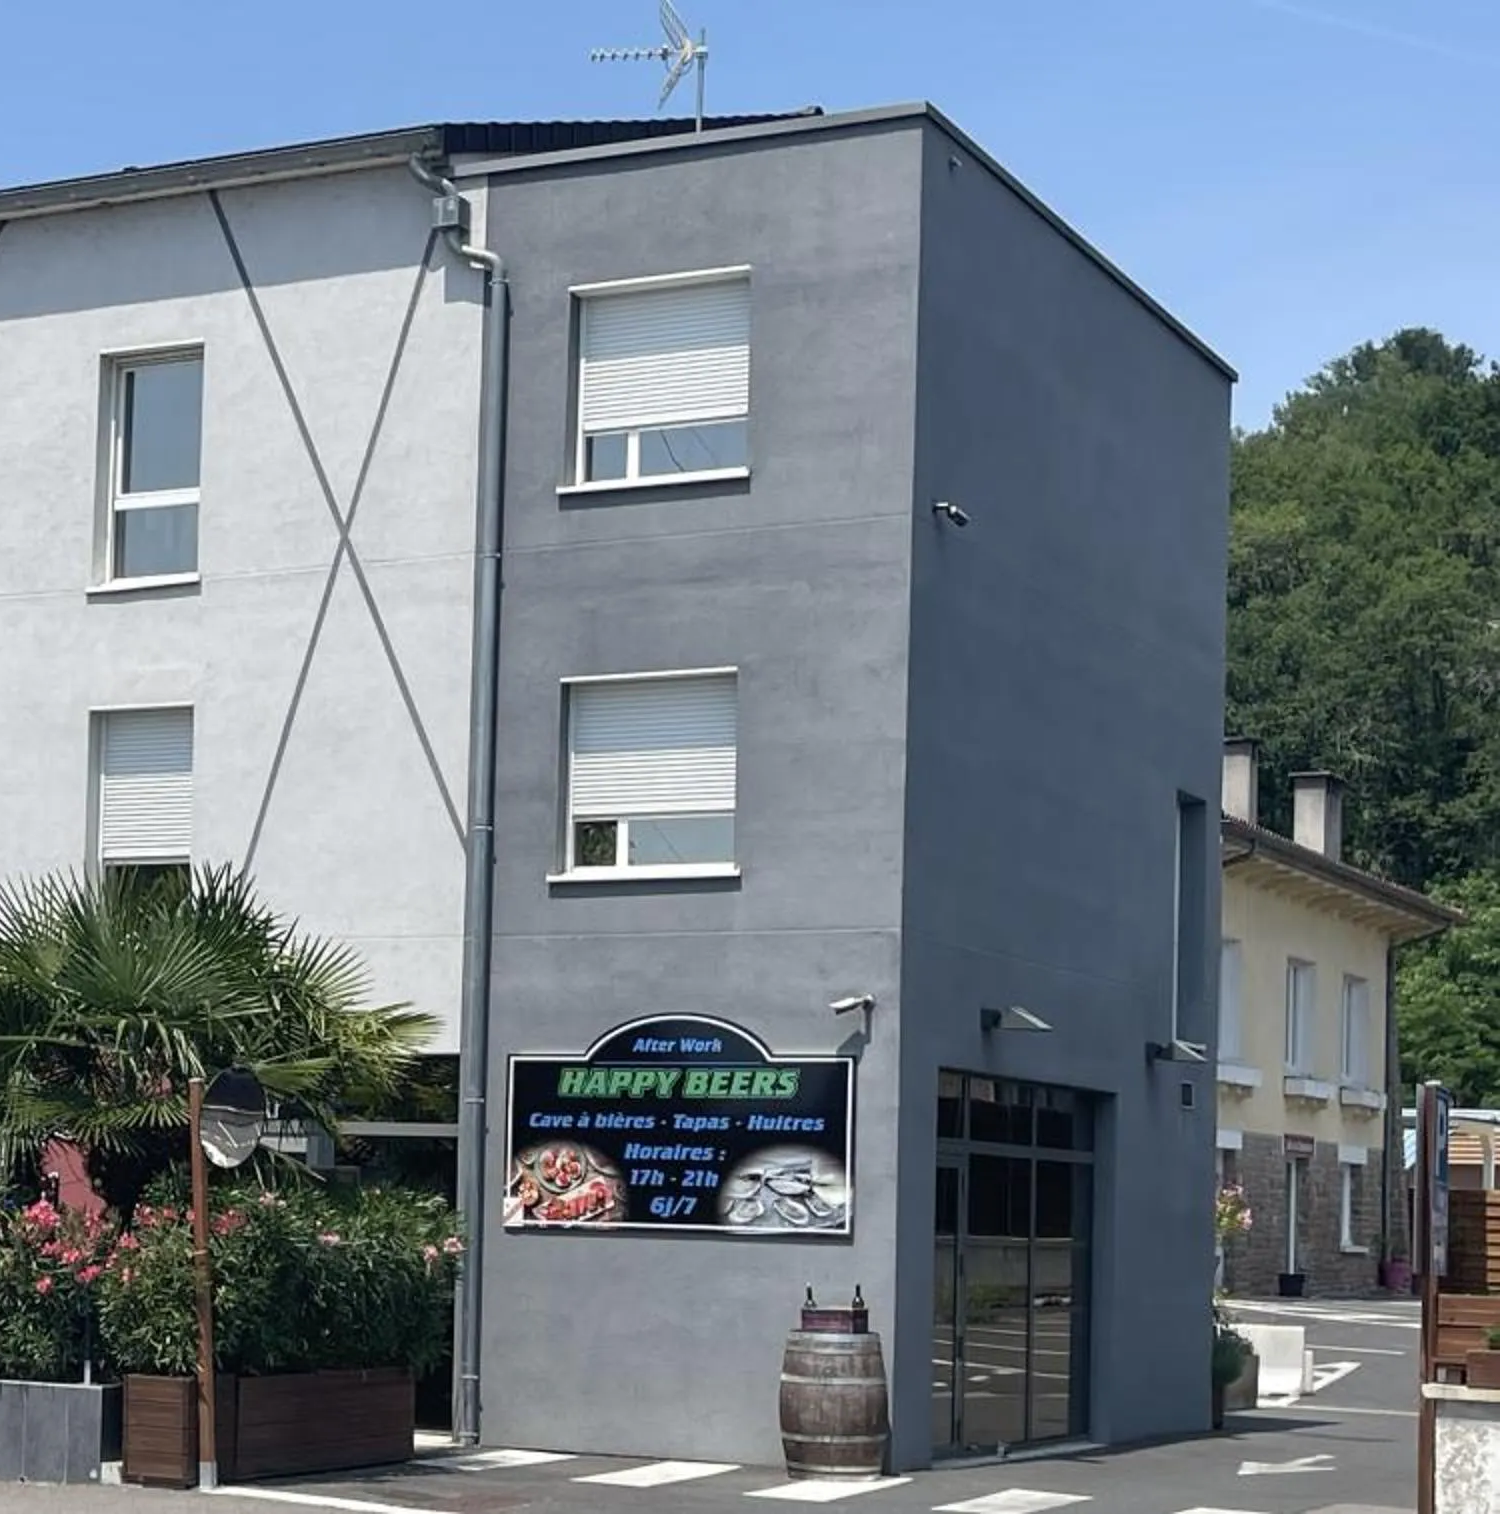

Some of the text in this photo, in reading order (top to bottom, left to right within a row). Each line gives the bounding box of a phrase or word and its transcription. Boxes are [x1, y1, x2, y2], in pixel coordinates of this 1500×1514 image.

[632, 1038, 722, 1053] After Work
[558, 1067, 800, 1098] HAPPY BEERS
[529, 1111, 574, 1129] Cave
[577, 1111, 591, 1129] à
[594, 1111, 656, 1129] bières
[673, 1113, 731, 1132] Tapas
[624, 1143, 715, 1161] Horaires
[629, 1168, 665, 1187] 17h
[681, 1169, 720, 1188] 21h
[649, 1195, 698, 1218] 6j/7
